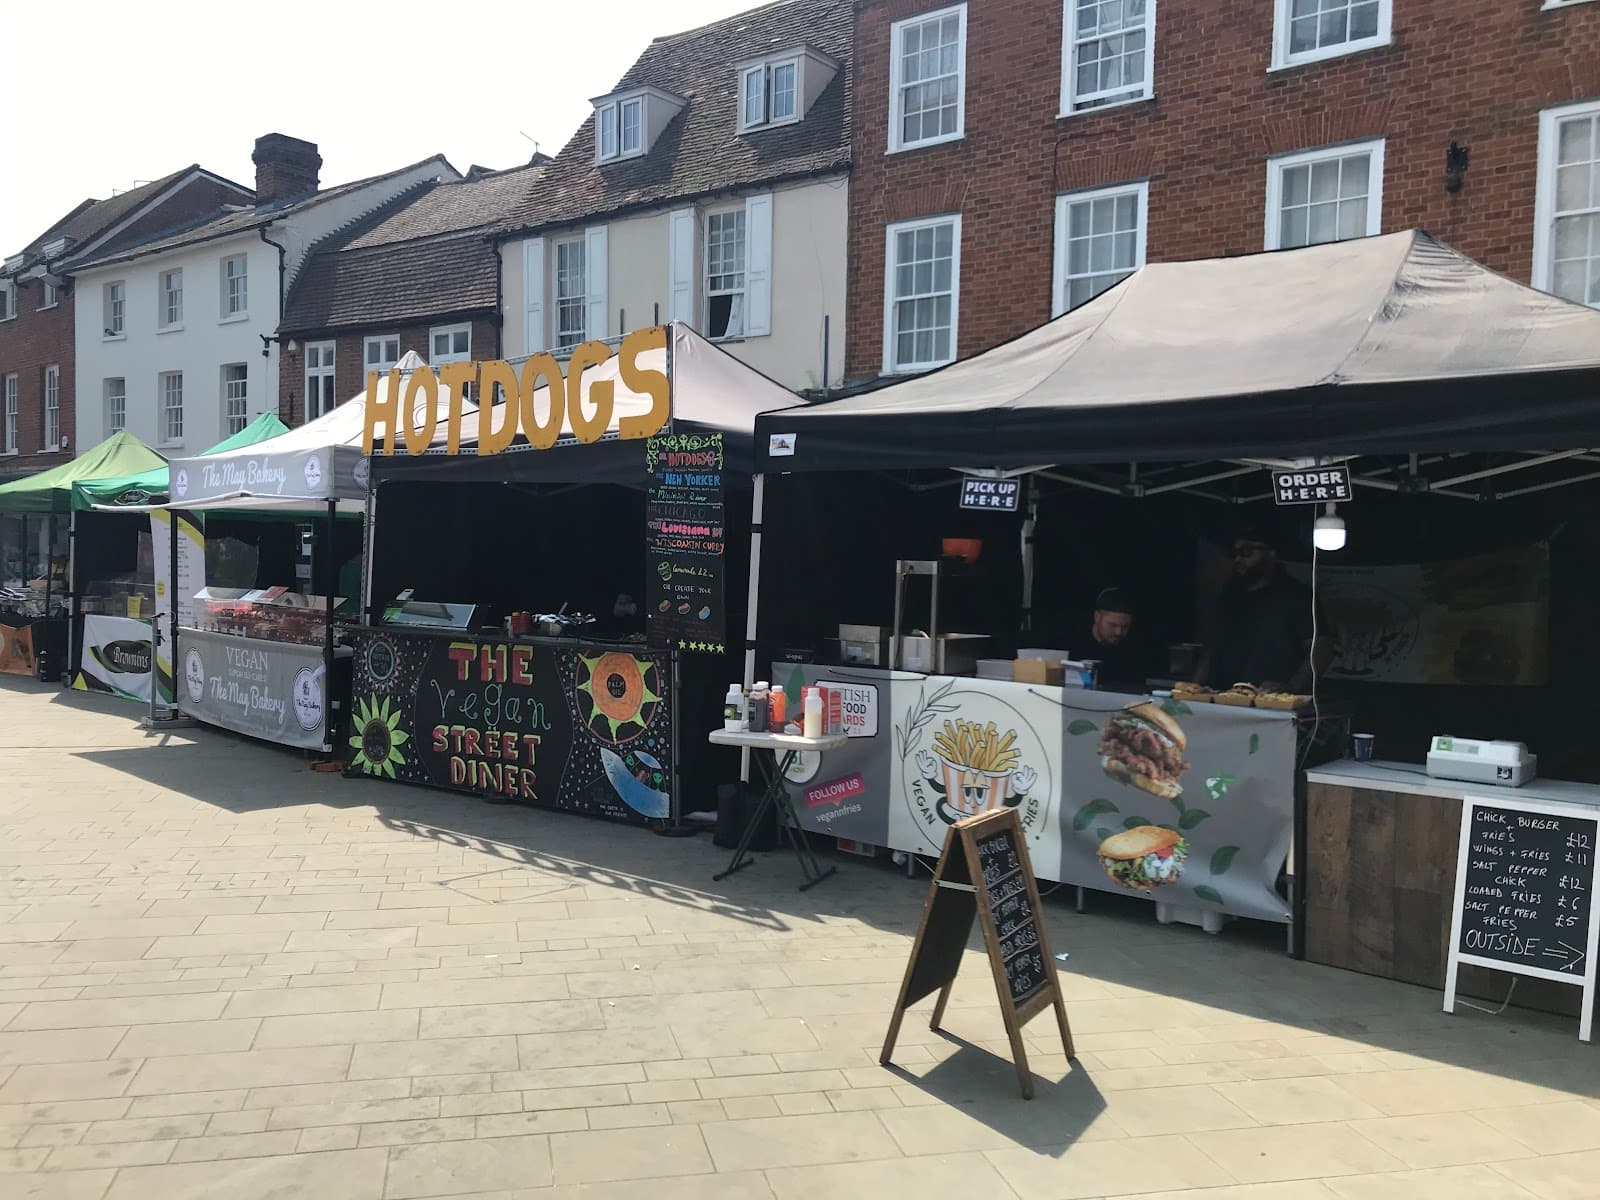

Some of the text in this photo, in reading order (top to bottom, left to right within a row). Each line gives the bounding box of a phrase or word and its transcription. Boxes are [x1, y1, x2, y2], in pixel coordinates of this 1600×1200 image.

[202, 457, 287, 494] The May Bakery
[684, 473, 721, 487] YORKER
[1278, 471, 1344, 488] ORDER
[966, 481, 1016, 495] PICK UP
[674, 584, 695, 593] CREATE
[225, 646, 269, 671] VEGAN
[448, 642, 534, 686] THE
[209, 676, 286, 725] The May Bakery
[843, 688, 871, 703] TISH
[450, 756, 539, 800] DINER
[808, 778, 860, 801] FOLLOW US
[912, 779, 936, 825] VEGAN
[815, 803, 862, 823] vegannfries
[1476, 811, 1560, 831] CHICK BURGER
[1481, 830, 1591, 849] FRIES £12
[1472, 843, 1504, 856] WINGS
[1520, 848, 1550, 861] FRIES
[1565, 851, 1588, 866] £11
[1472, 860, 1548, 877] SALT PEPPER
[1494, 874, 1585, 891] CHICK £12
[1468, 885, 1503, 898] LOADED
[1511, 891, 1542, 905] FRIES
[1464, 900, 1490, 913] SALT
[1482, 914, 1580, 931] FRIES £5
[1465, 928, 1541, 957] OUTSIDE
